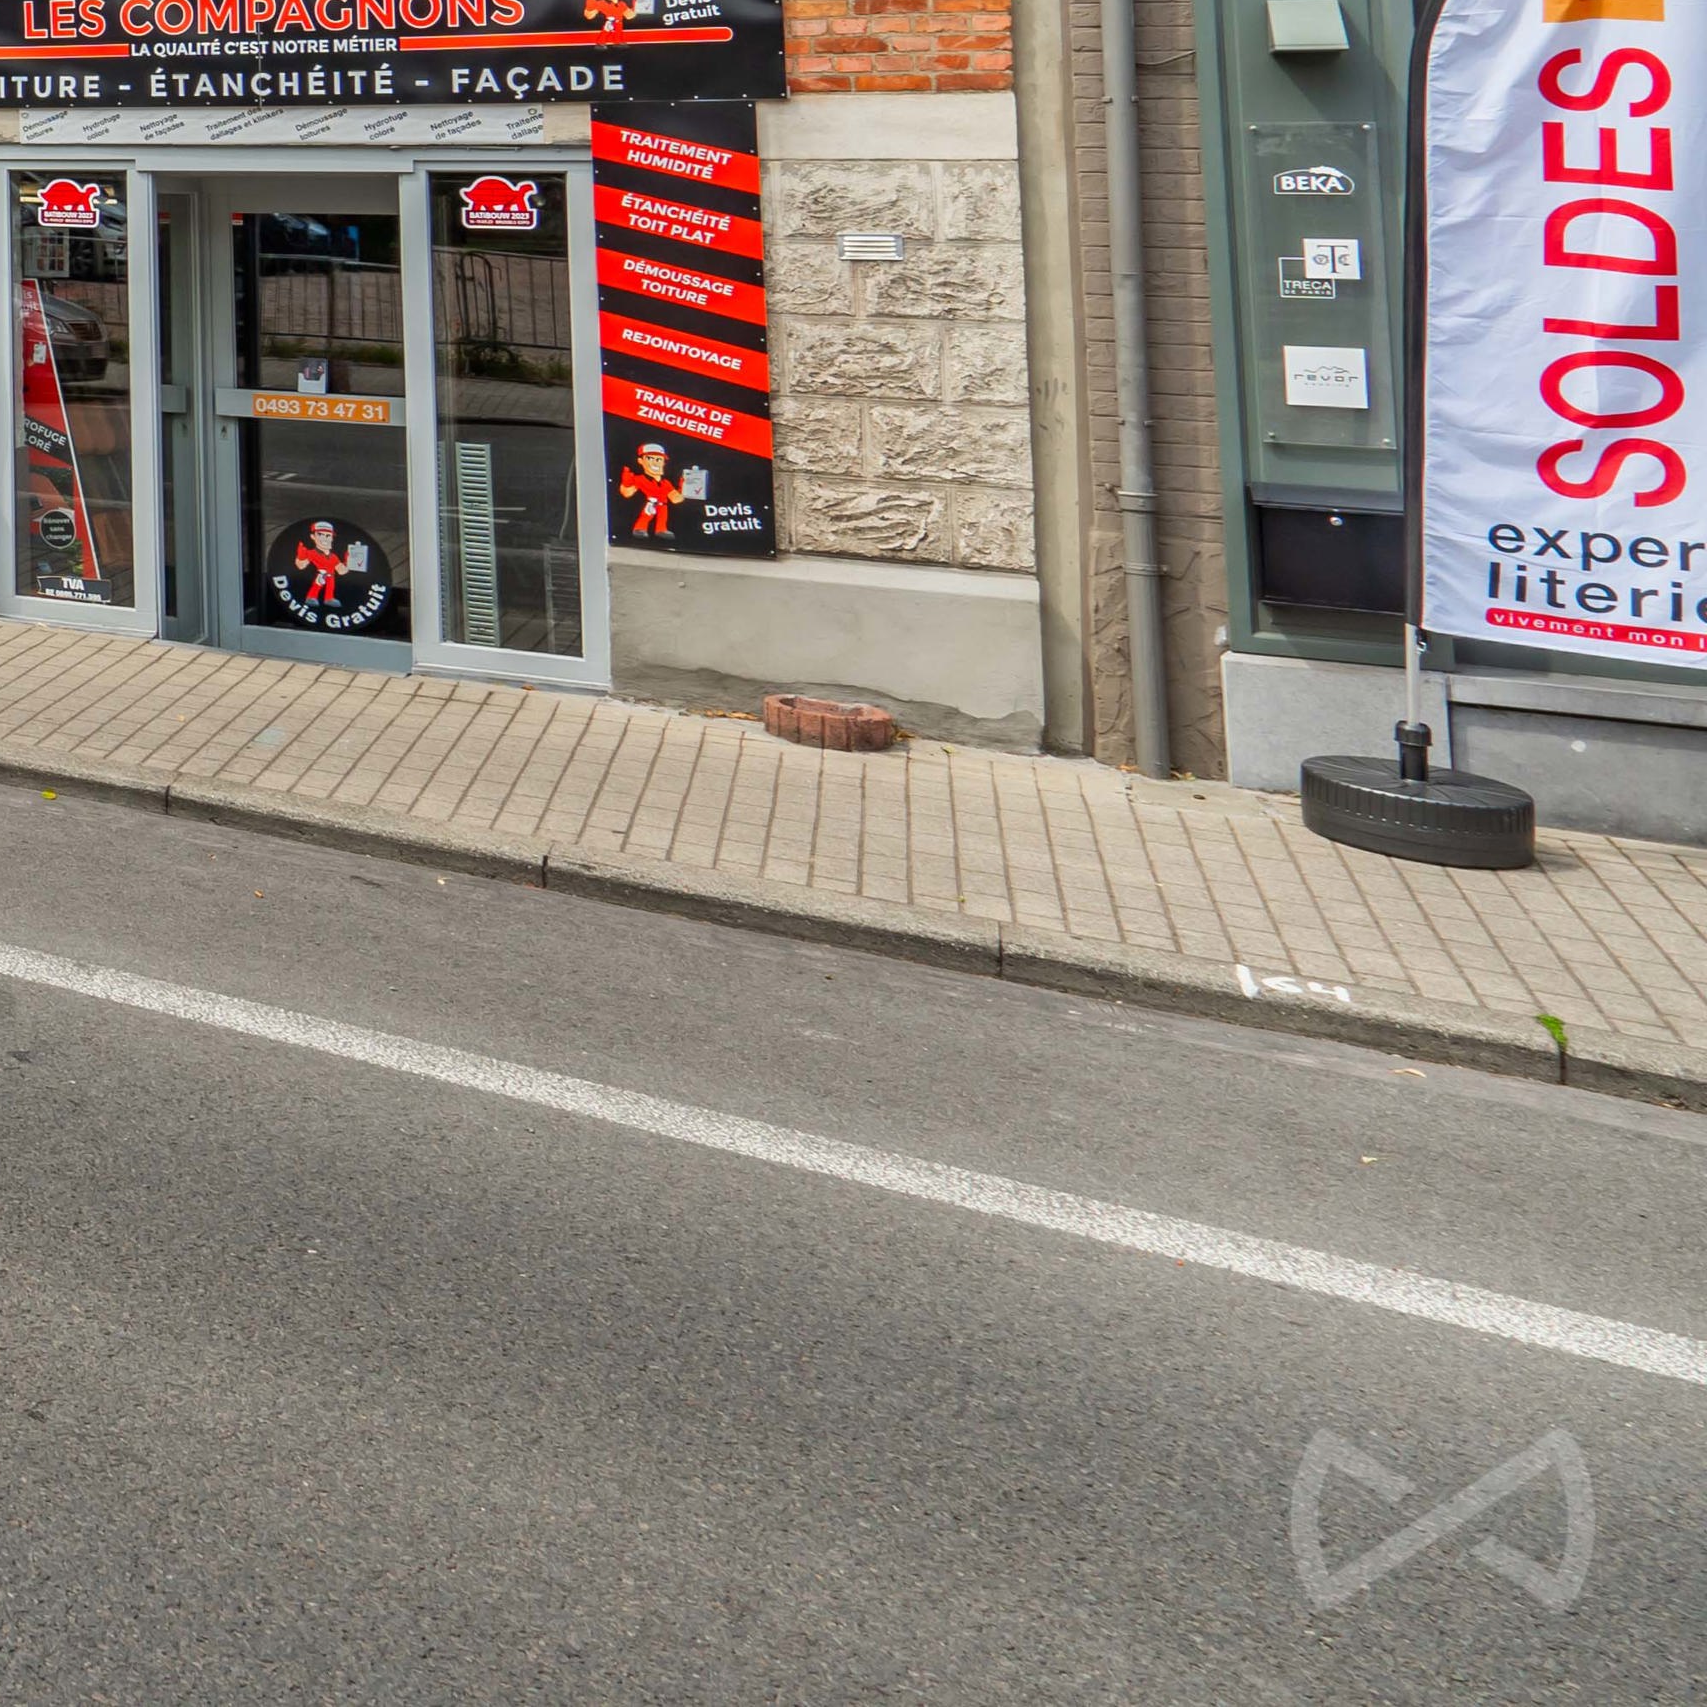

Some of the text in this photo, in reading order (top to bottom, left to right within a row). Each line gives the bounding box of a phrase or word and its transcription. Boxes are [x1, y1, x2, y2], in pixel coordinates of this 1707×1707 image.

[23, 0, 106, 39] LES
[662, 5, 721, 25] gratuit
[131, 34, 398, 57] LA QUALITÉ C'EST NOTRE MÉTIER
[150, 63, 393, 97] ÉTANCHÉITÉ
[452, 65, 624, 99] FAÇADE
[82, 112, 121, 134] Hydrofuge
[139, 112, 178, 133] Nettoyage
[155, 121, 185, 139] façades
[205, 111, 246, 132] Traitement
[209, 123, 243, 141] dallages
[252, 107, 284, 125] klinkers
[294, 107, 348, 132] Démoussage
[363, 110, 408, 132] Hydrofuge
[429, 110, 474, 131] Nettoyage
[435, 118, 482, 141] de façades
[299, 125, 331, 141] toitures
[369, 125, 396, 141] coloré
[620, 130, 732, 166] TRAITEMENT
[627, 150, 714, 179] HUMIDITÉ
[1280, 175, 1345, 192] BEKA
[621, 193, 731, 231] ÉTANCHÉITÉ
[628, 214, 715, 245] TOIT PLAT
[623, 259, 734, 296] DÉMOUSSAGE
[1283, 279, 1332, 290] TRECA
[1536, 48, 1686, 507] SOLDES
[640, 279, 708, 305] TOITURE
[622, 329, 742, 370] REJOINTOYAGE
[255, 398, 384, 420] 0493 73 47 31
[635, 388, 733, 426] TRAVAUX DE
[637, 405, 724, 440] ZINGUERIE
[704, 503, 752, 516] Devis
[701, 517, 762, 534] gratuit
[1488, 523, 1706, 572] exper
[62, 578, 85, 590] TVA
[1488, 562, 1707, 624] literi
[272, 575, 386, 629] Devis Gratuit
[1494, 613, 1615, 639] vivement
[1628, 632, 1684, 647] mon
